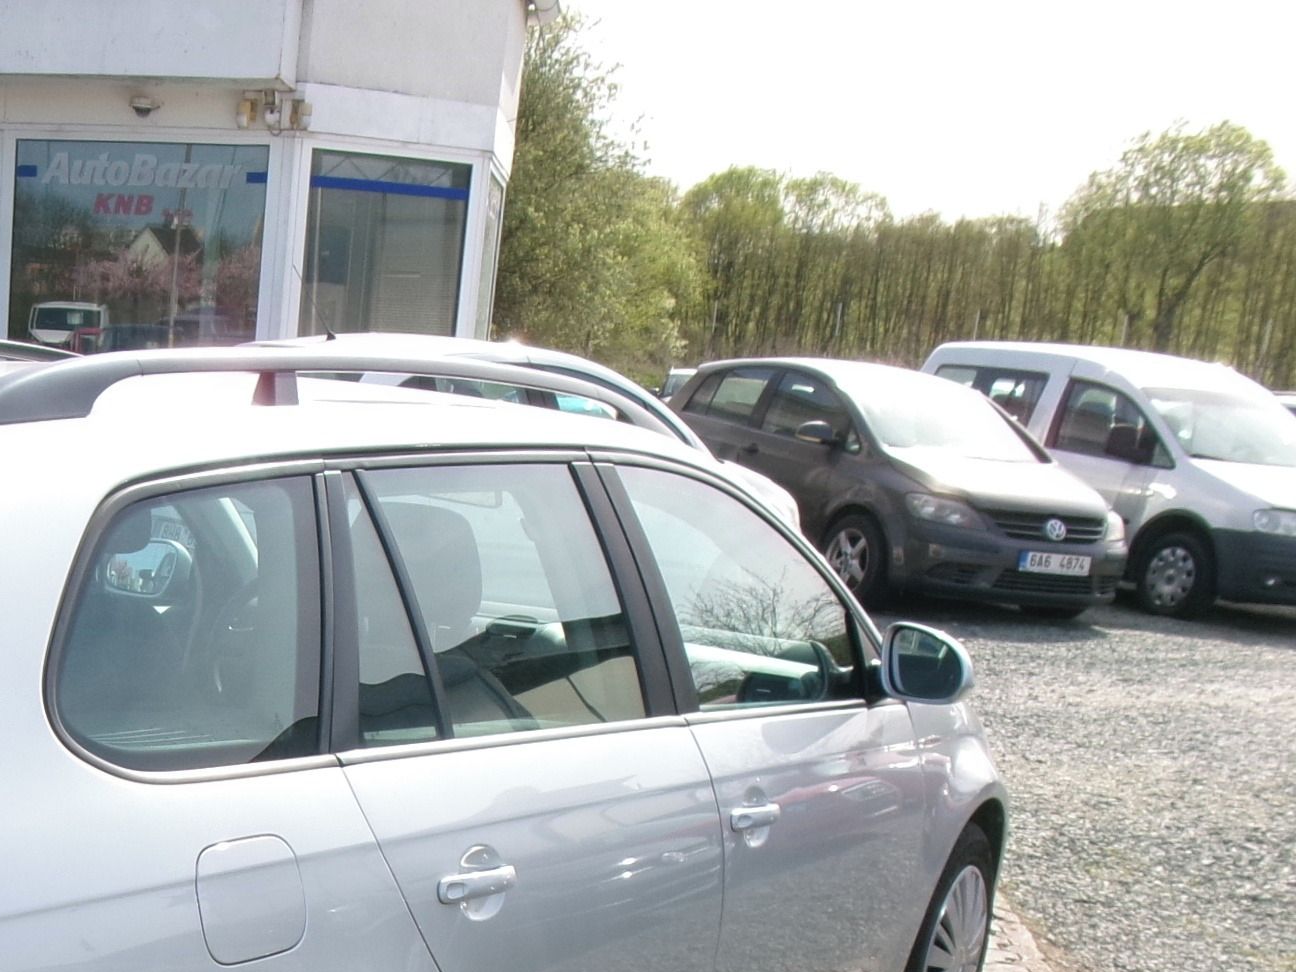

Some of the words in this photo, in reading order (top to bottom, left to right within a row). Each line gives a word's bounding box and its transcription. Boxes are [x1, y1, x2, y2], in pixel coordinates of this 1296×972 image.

[41, 151, 242, 189] AutoBazar
[93, 192, 155, 216] KNB
[1030, 554, 1052, 569] 6A6
